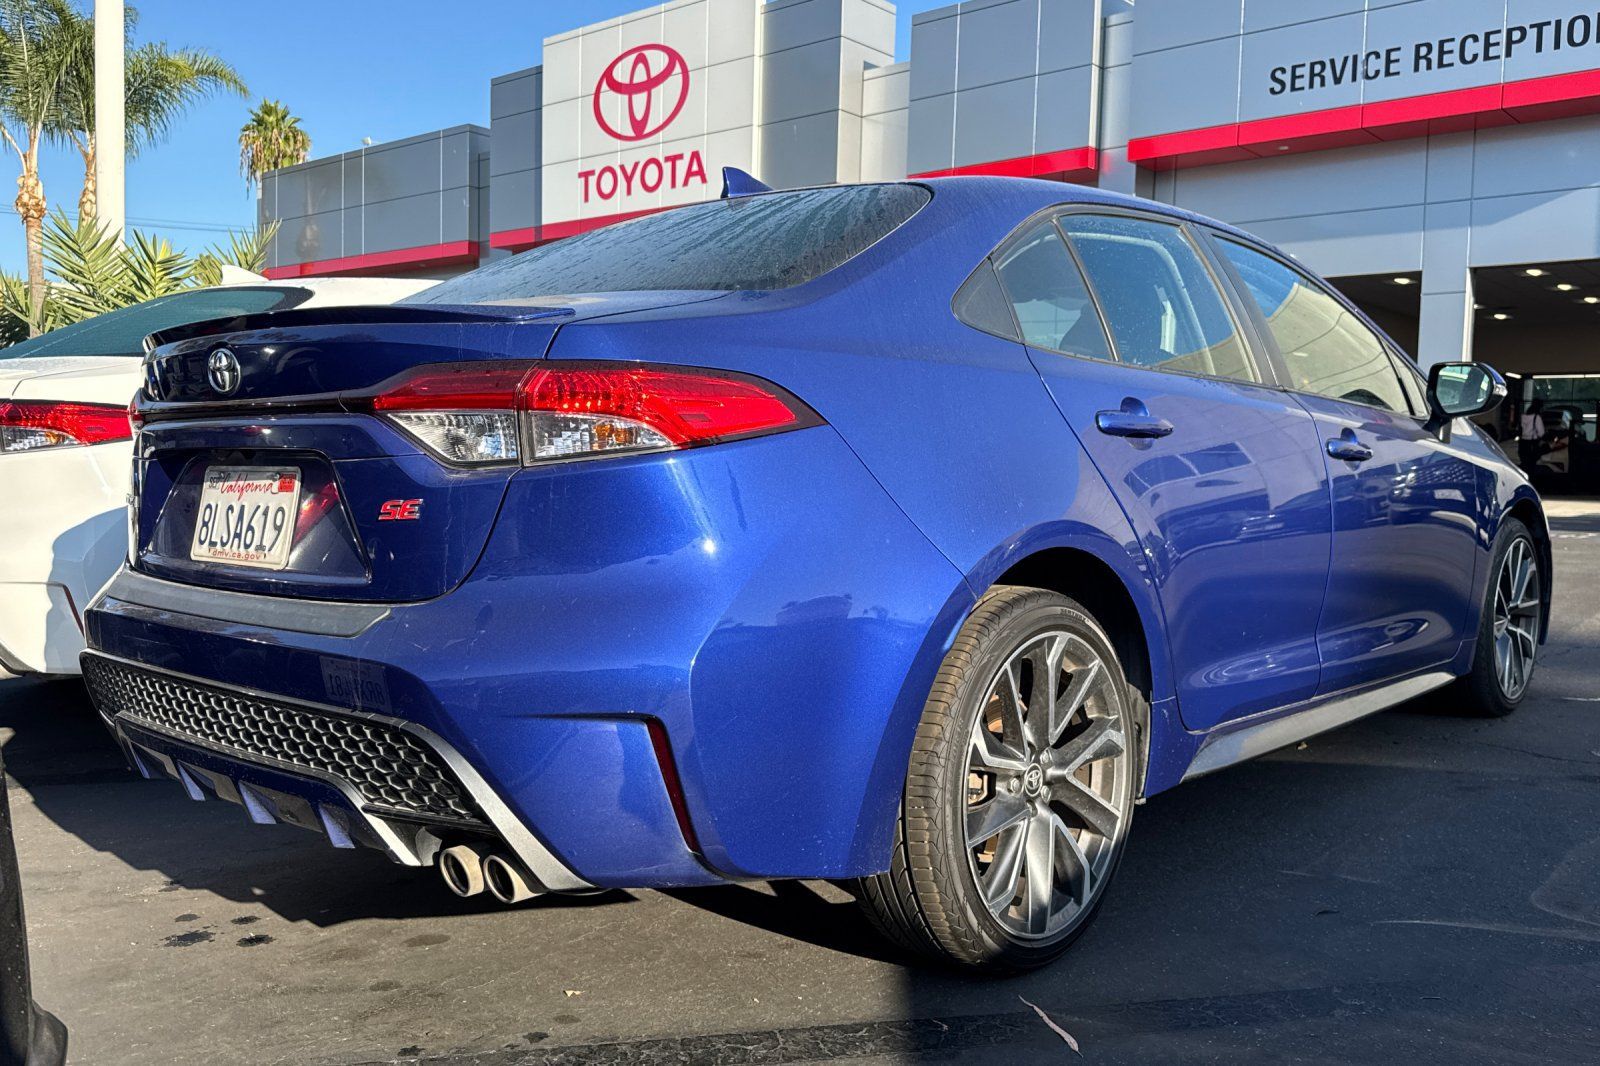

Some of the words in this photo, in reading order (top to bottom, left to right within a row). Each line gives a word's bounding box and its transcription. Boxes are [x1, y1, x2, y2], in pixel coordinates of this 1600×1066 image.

[1269, 46, 1401, 95] SERVICE
[1413, 12, 1600, 73] RECEPTIO
[578, 150, 708, 203] TOYOTA
[220, 473, 274, 501] California
[198, 503, 286, 552] 8LSA619
[378, 498, 424, 520] SE
[212, 548, 261, 560] dmv.ca.gov
